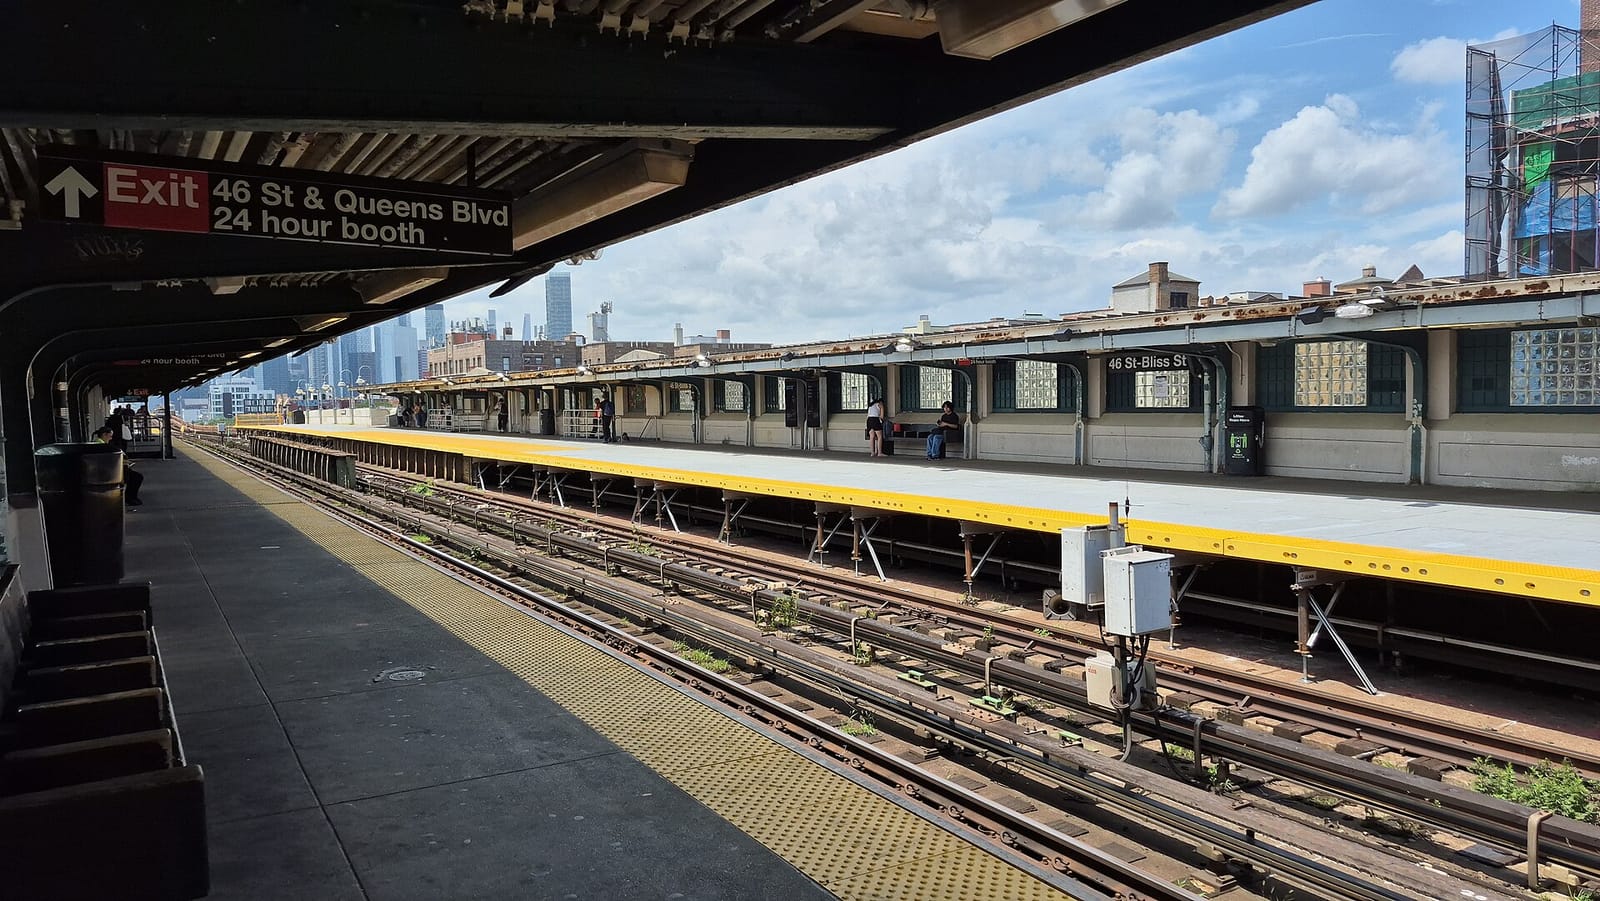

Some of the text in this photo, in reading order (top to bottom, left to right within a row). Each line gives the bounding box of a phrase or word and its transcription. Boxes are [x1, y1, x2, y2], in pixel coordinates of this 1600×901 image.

[107, 166, 200, 210] Exit
[212, 178, 509, 228] 46 St & Queens Blvd
[213, 206, 426, 246] 24 hour booth
[1108, 354, 1188, 370] 46 St-Bliss St
